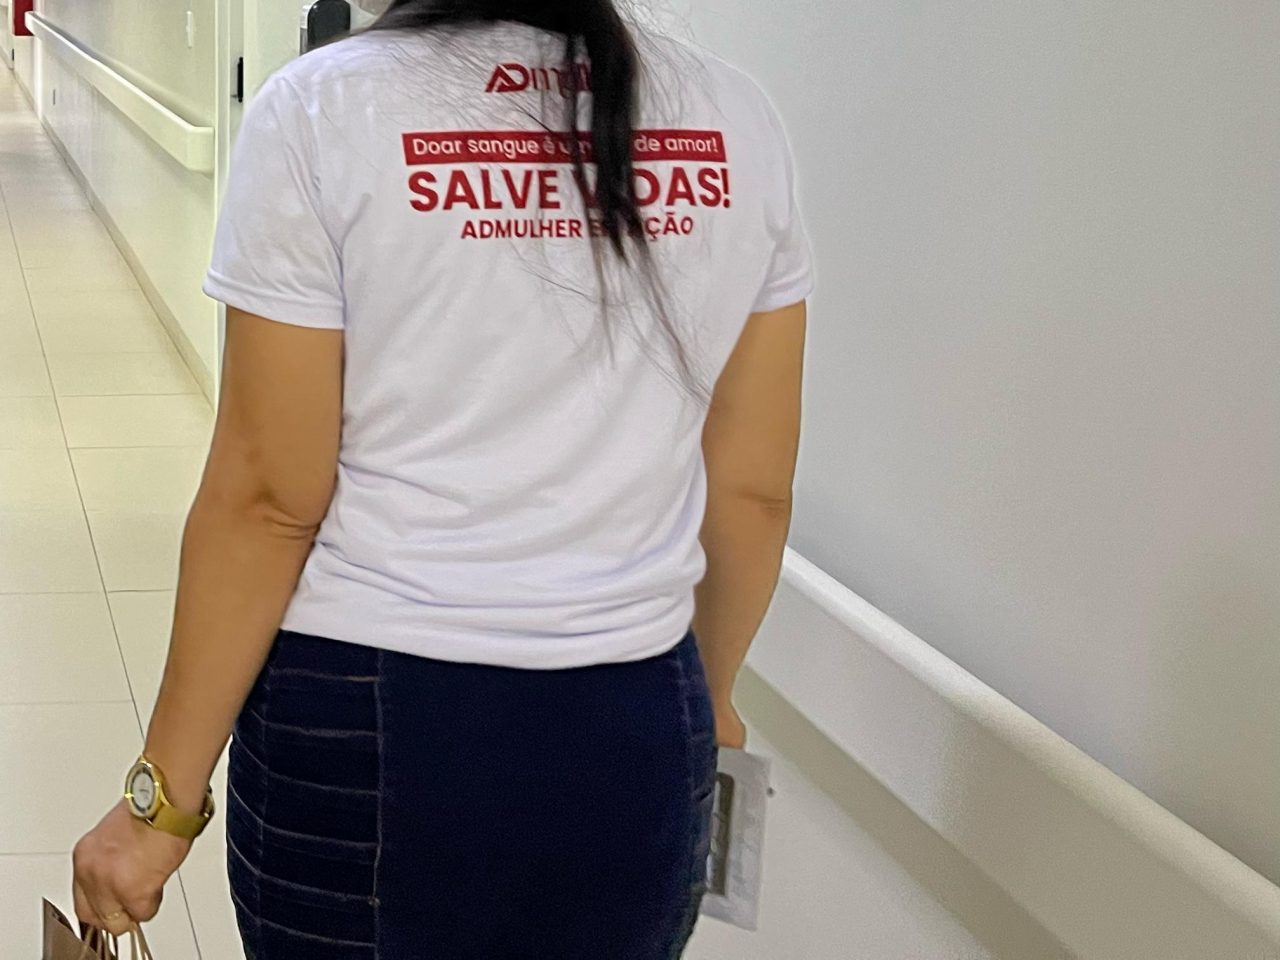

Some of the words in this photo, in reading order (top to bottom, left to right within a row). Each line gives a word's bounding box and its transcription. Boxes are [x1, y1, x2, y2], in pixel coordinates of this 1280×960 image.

[412, 138, 462, 156] Doar
[468, 138, 540, 160] sangue
[634, 134, 660, 152] de
[665, 136, 720, 153] amor!
[408, 168, 561, 213] SALVE
[571, 166, 731, 209] VDAS!
[461, 218, 583, 239] ADMULHER
